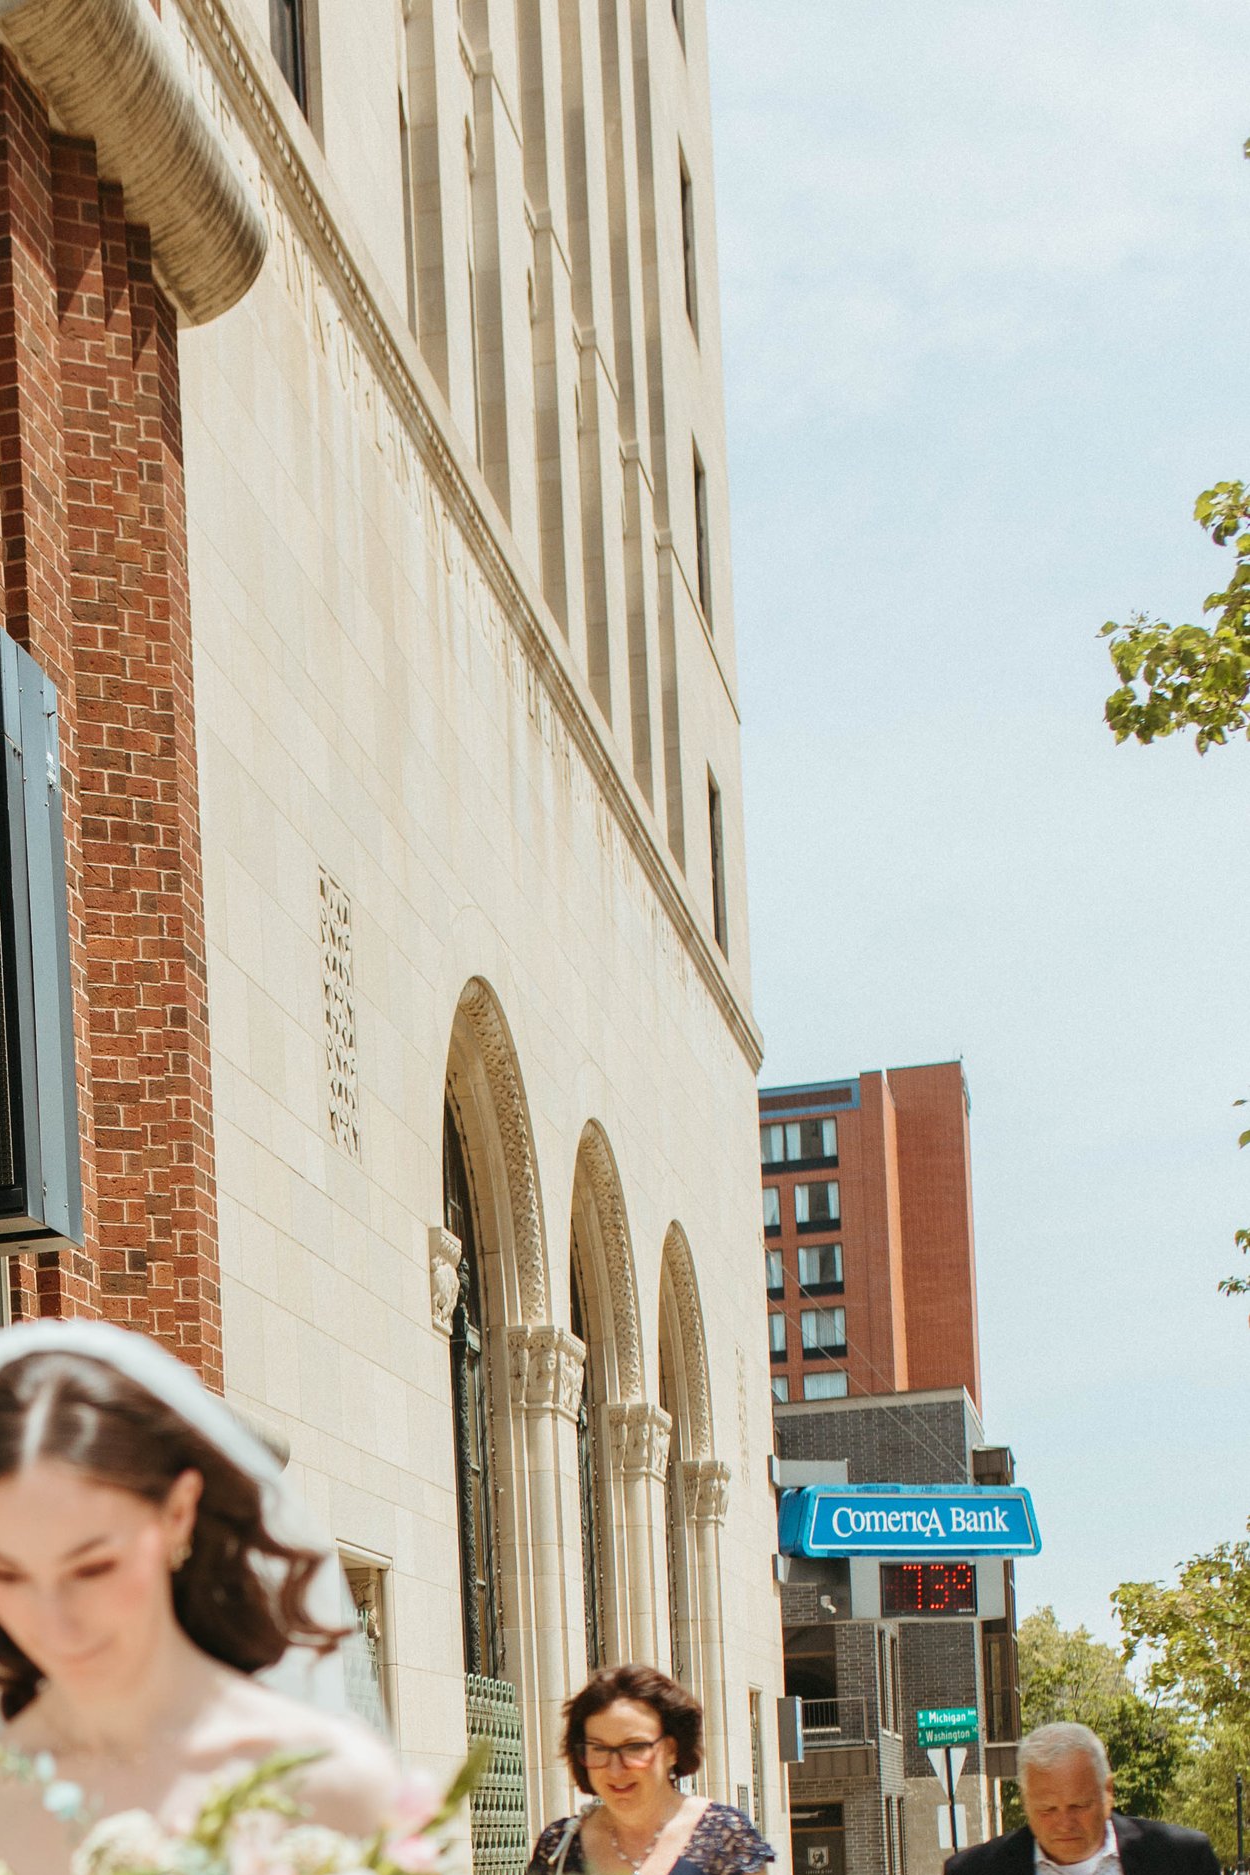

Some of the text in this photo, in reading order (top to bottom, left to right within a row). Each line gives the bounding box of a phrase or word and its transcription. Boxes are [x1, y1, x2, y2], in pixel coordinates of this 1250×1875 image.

[950, 1506, 1010, 1532] Bank
[929, 1711, 966, 1725] Michigan
[926, 1729, 970, 1742] Washington
